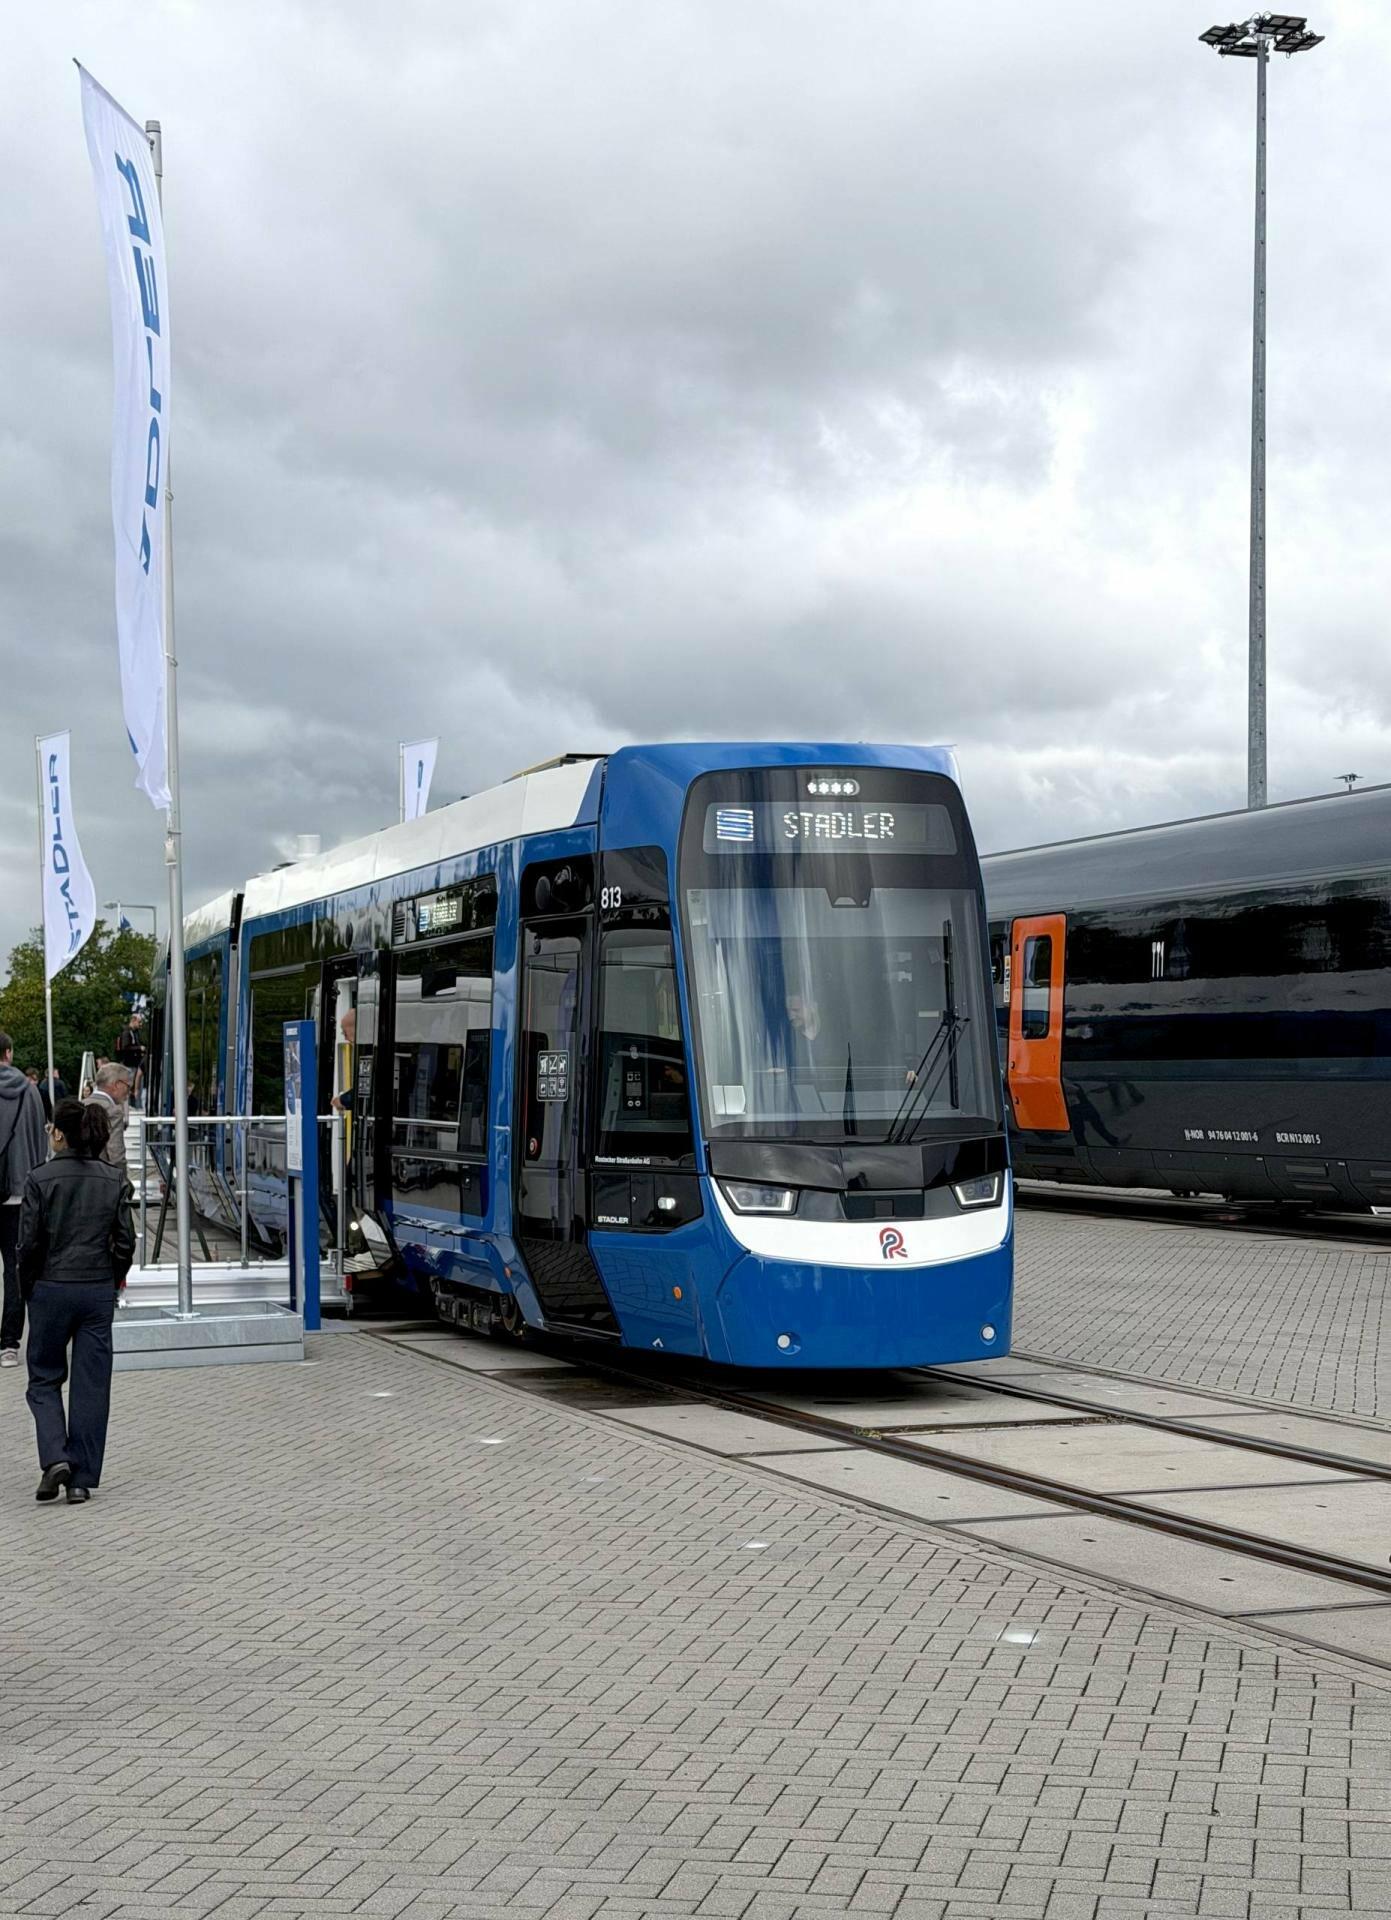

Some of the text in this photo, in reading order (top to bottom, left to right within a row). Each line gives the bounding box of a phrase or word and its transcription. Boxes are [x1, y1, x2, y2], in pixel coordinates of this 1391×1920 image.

[783, 811, 895, 838] STADLER
[48, 753, 82, 953] STADLER
[601, 886, 621, 909] 813
[597, 1215, 629, 1225] STADLER
